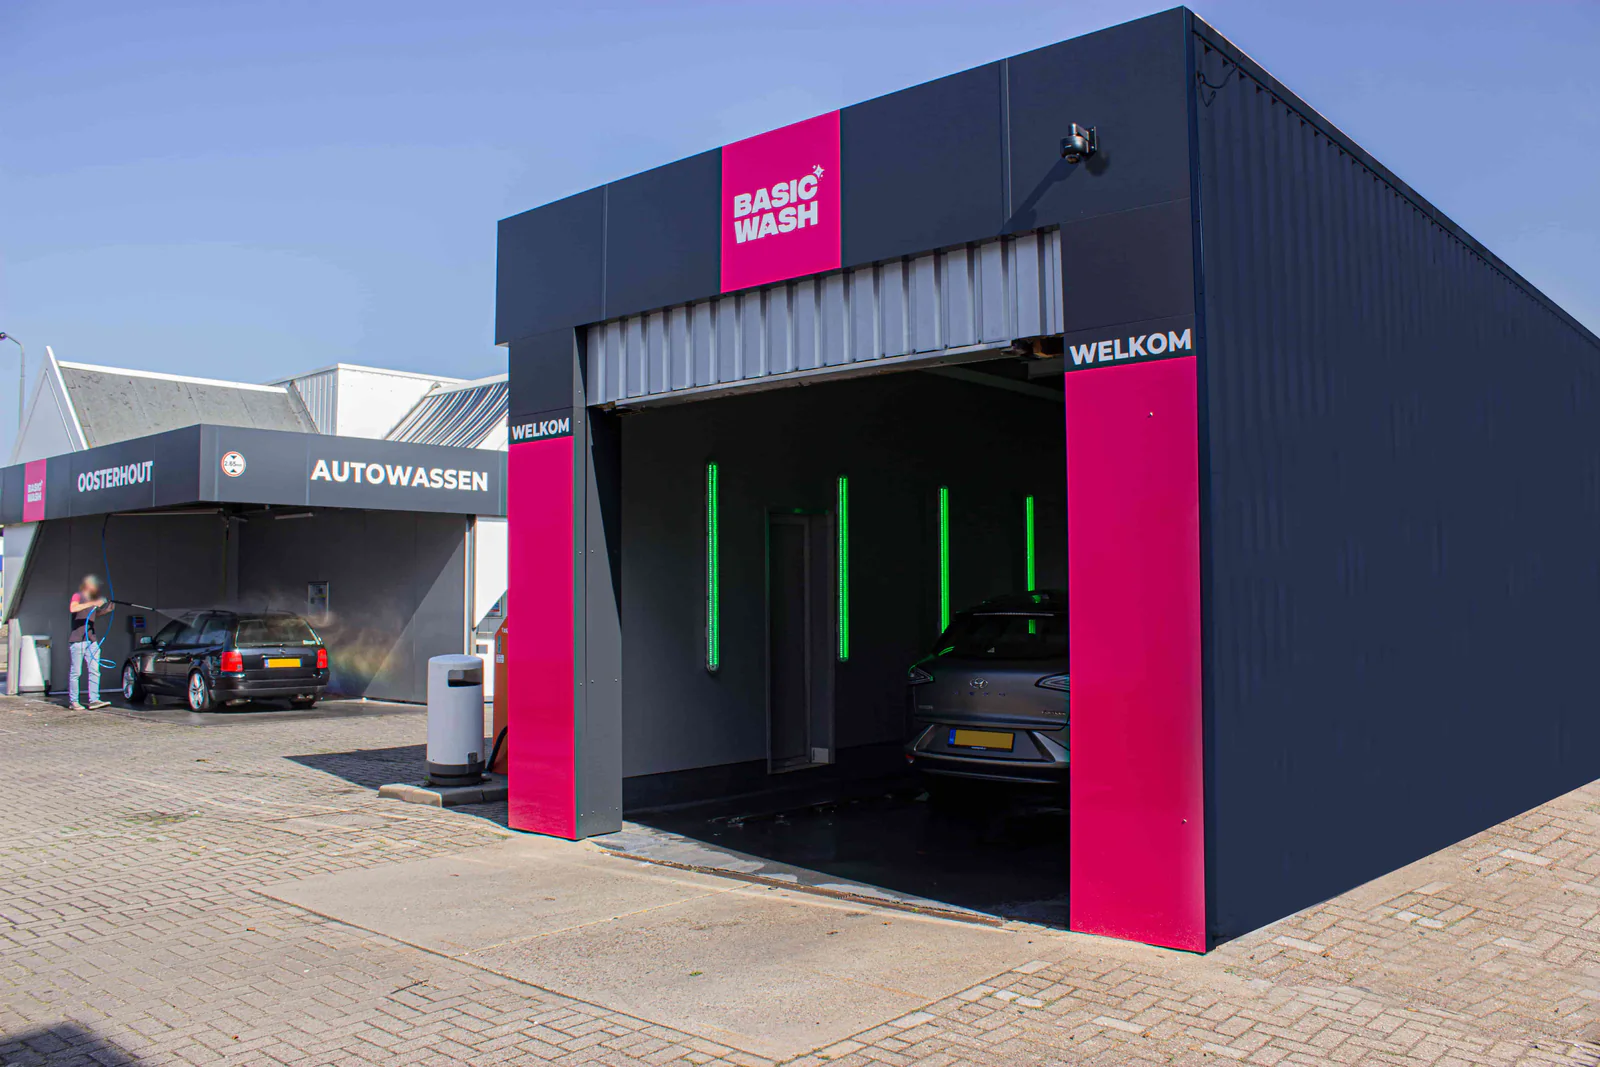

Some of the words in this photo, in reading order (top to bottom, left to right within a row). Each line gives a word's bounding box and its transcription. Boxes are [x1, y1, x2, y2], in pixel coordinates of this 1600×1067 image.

[734, 174, 818, 218] BASIC
[734, 200, 818, 244] WASH
[1069, 328, 1192, 365] WELKOM
[511, 417, 570, 440] WELKOM
[77, 460, 154, 493] OOSTERHOUT
[310, 459, 489, 492] AUTOWASSEN
